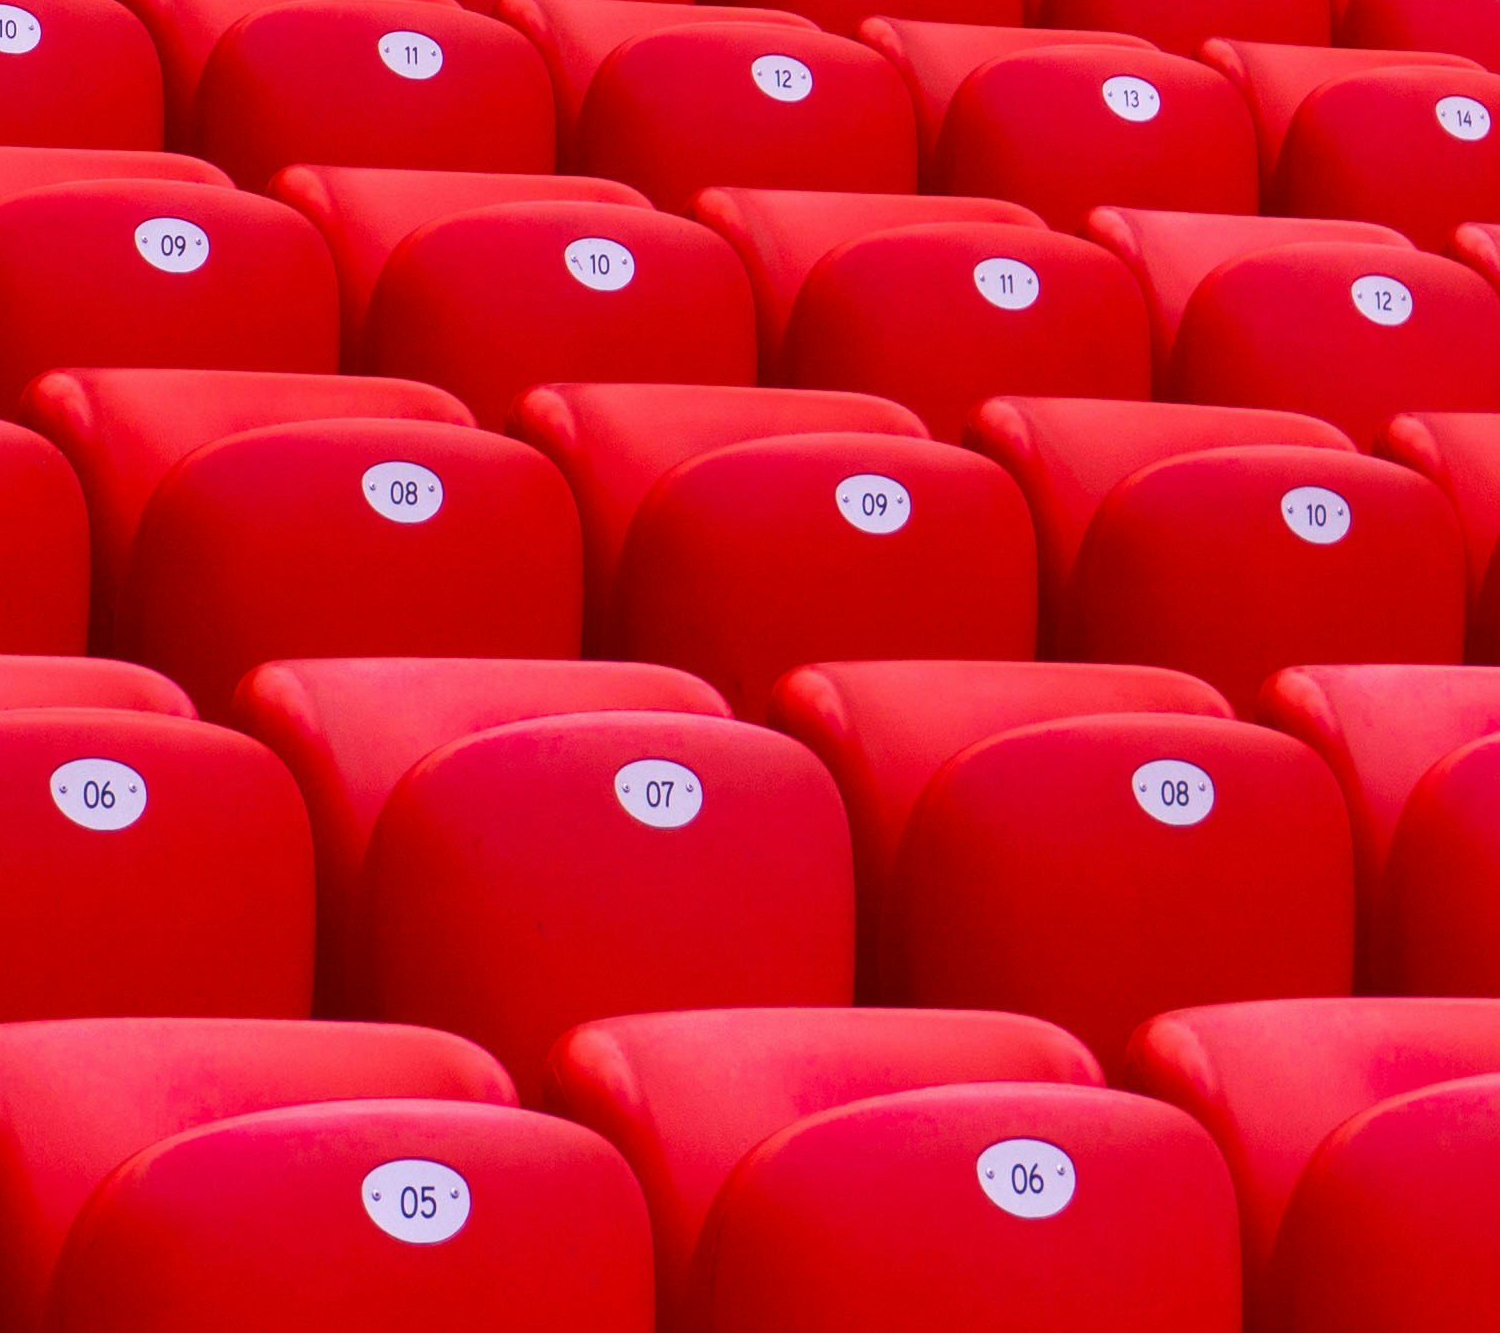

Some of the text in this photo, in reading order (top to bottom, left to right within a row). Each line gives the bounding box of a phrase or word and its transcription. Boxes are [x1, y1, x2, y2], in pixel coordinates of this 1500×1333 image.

[404, 46, 418, 66] 11
[774, 69, 793, 89] 12
[1123, 89, 1140, 109] 13
[1456, 109, 1473, 128] 14
[160, 234, 187, 257] 09
[589, 253, 610, 276] 10
[999, 273, 1014, 294] 11
[1374, 290, 1393, 312] 12
[390, 480, 418, 506] 08
[862, 492, 888, 517] 09
[1306, 503, 1327, 528] 10
[83, 780, 116, 810] 06
[646, 780, 675, 808] 07
[1161, 779, 1190, 807] 08
[1011, 1163, 1045, 1196] 06
[400, 1185, 437, 1220] 05
